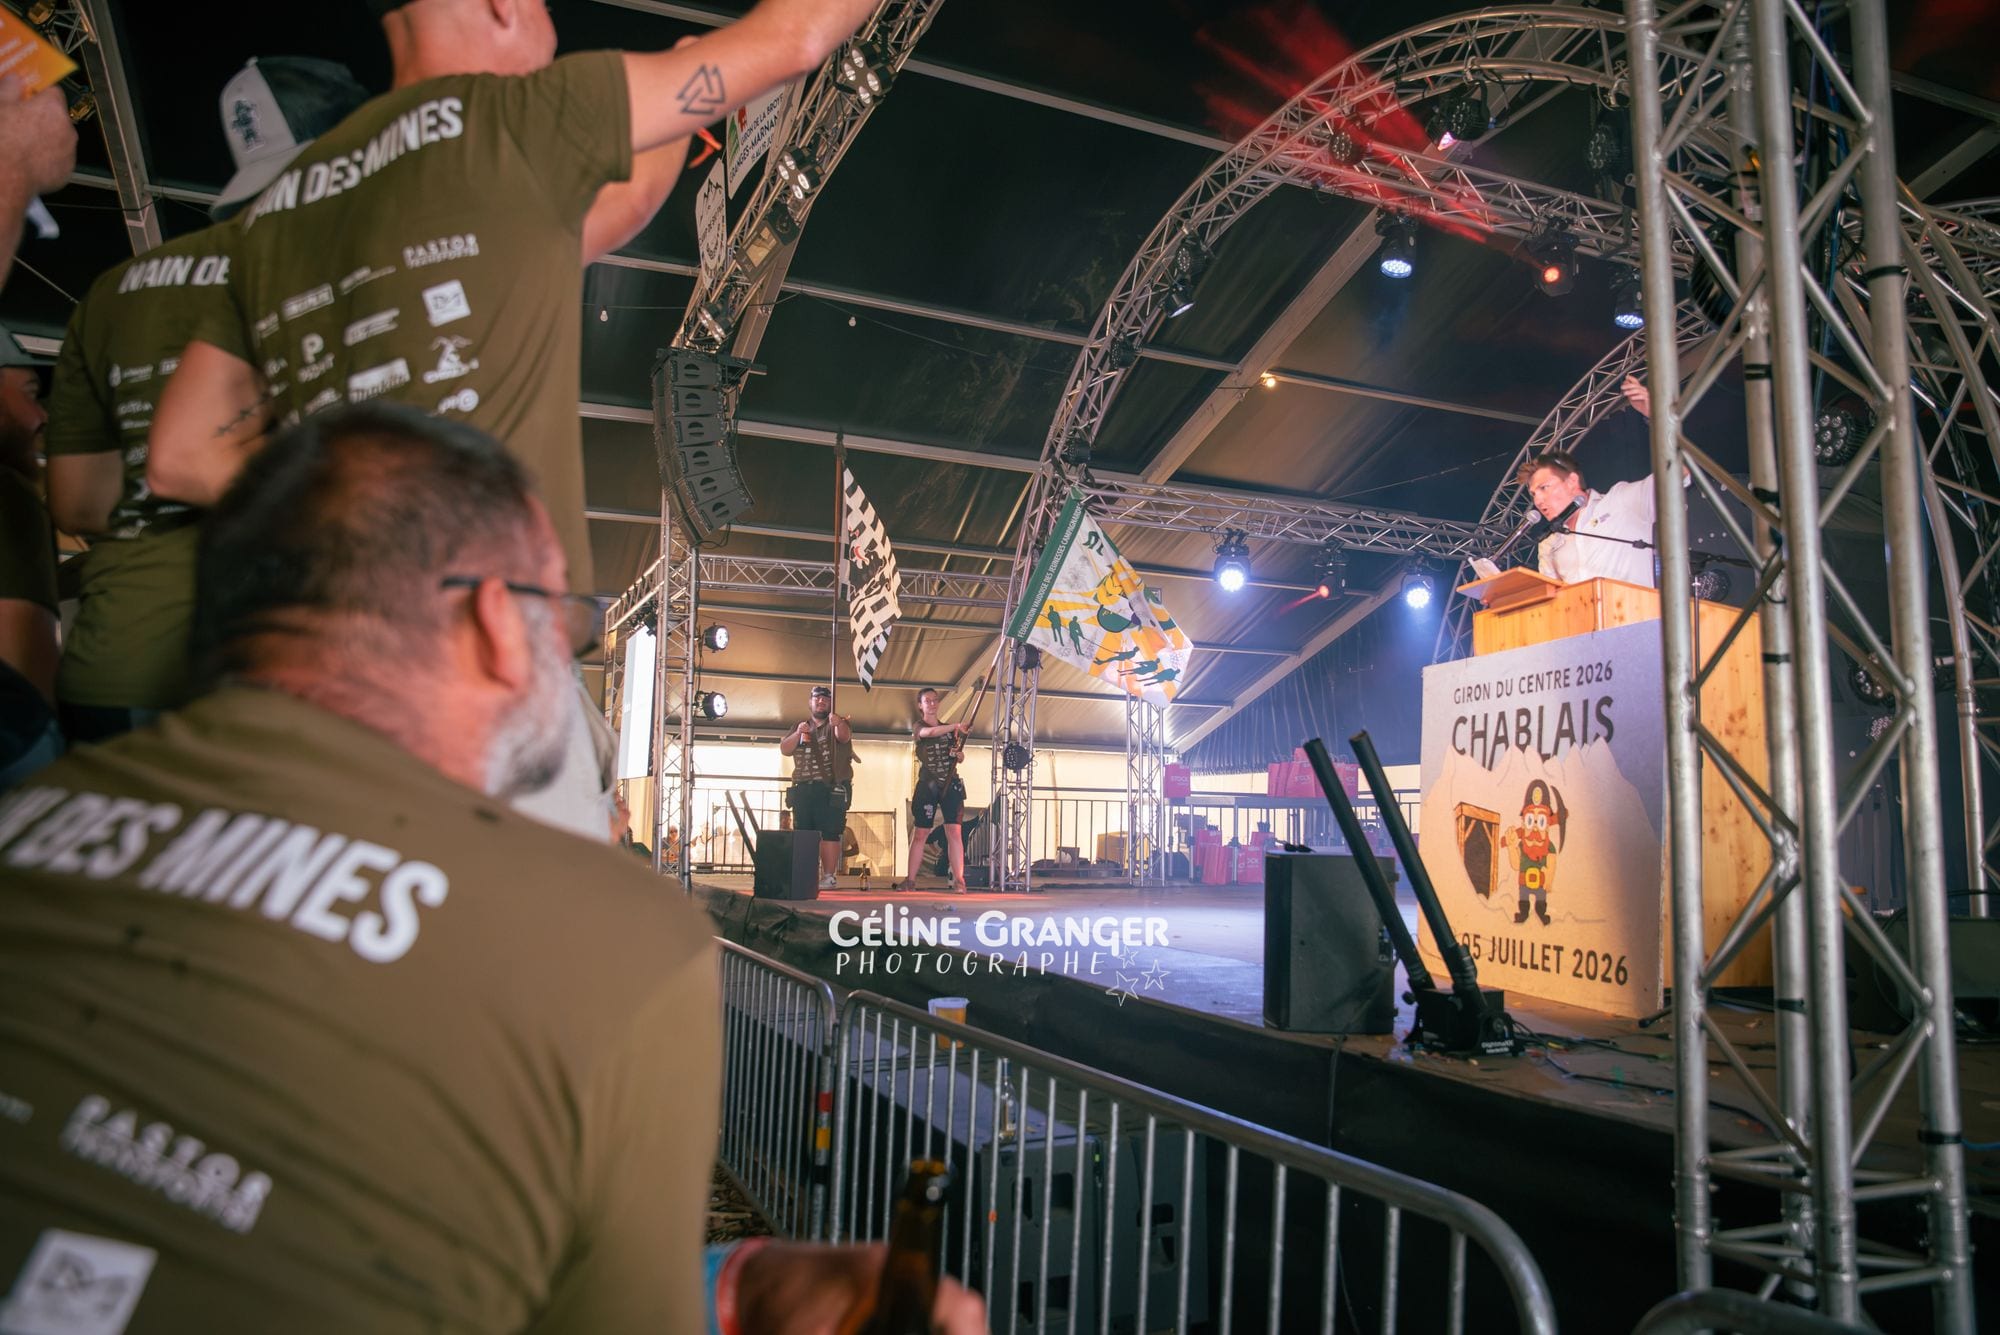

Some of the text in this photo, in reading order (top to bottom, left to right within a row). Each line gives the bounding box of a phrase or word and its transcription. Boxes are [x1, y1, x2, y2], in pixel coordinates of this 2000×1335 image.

[303, 149, 363, 204] DES
[362, 97, 464, 178] MINES
[1453, 660, 1613, 704] GIRON DU CENTRE 2026
[1452, 696, 1614, 771] CHABLAIS
[138, 808, 449, 963] MINES
[1488, 936, 1564, 974] JUILLET
[1572, 948, 1628, 986] 2026
